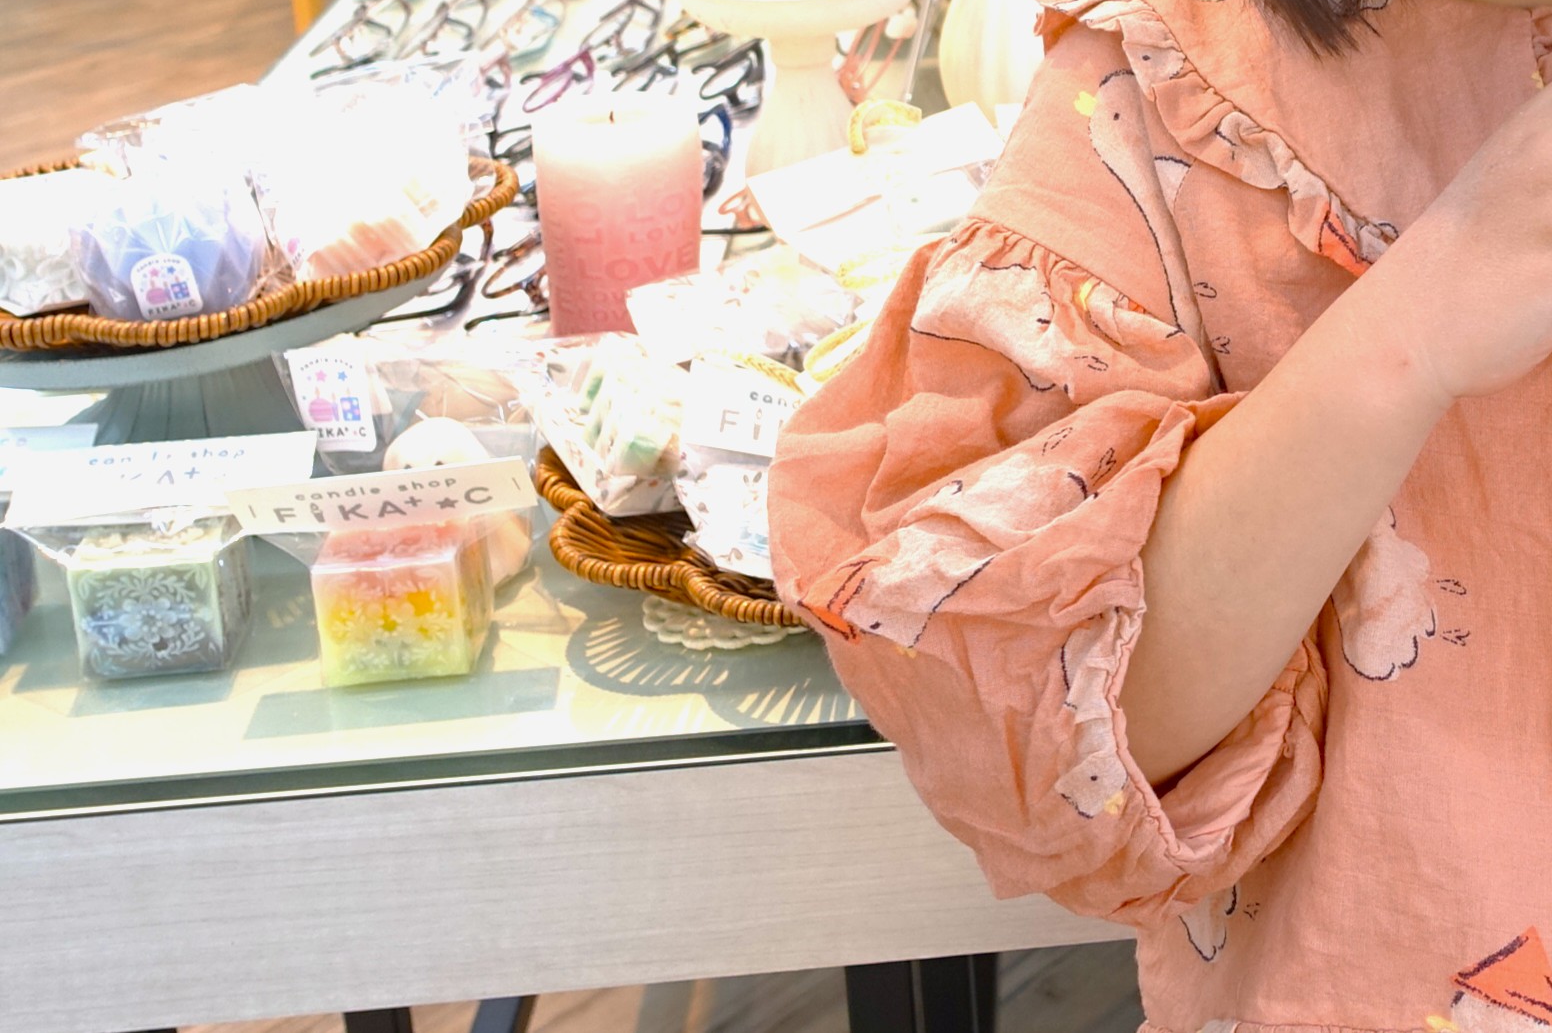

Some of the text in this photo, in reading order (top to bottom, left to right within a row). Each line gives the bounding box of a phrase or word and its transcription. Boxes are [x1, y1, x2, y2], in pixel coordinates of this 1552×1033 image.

[577, 241, 696, 282] LOVE
[190, 448, 246, 460] shop
[294, 476, 458, 502] candle shop
[463, 486, 494, 505] C
